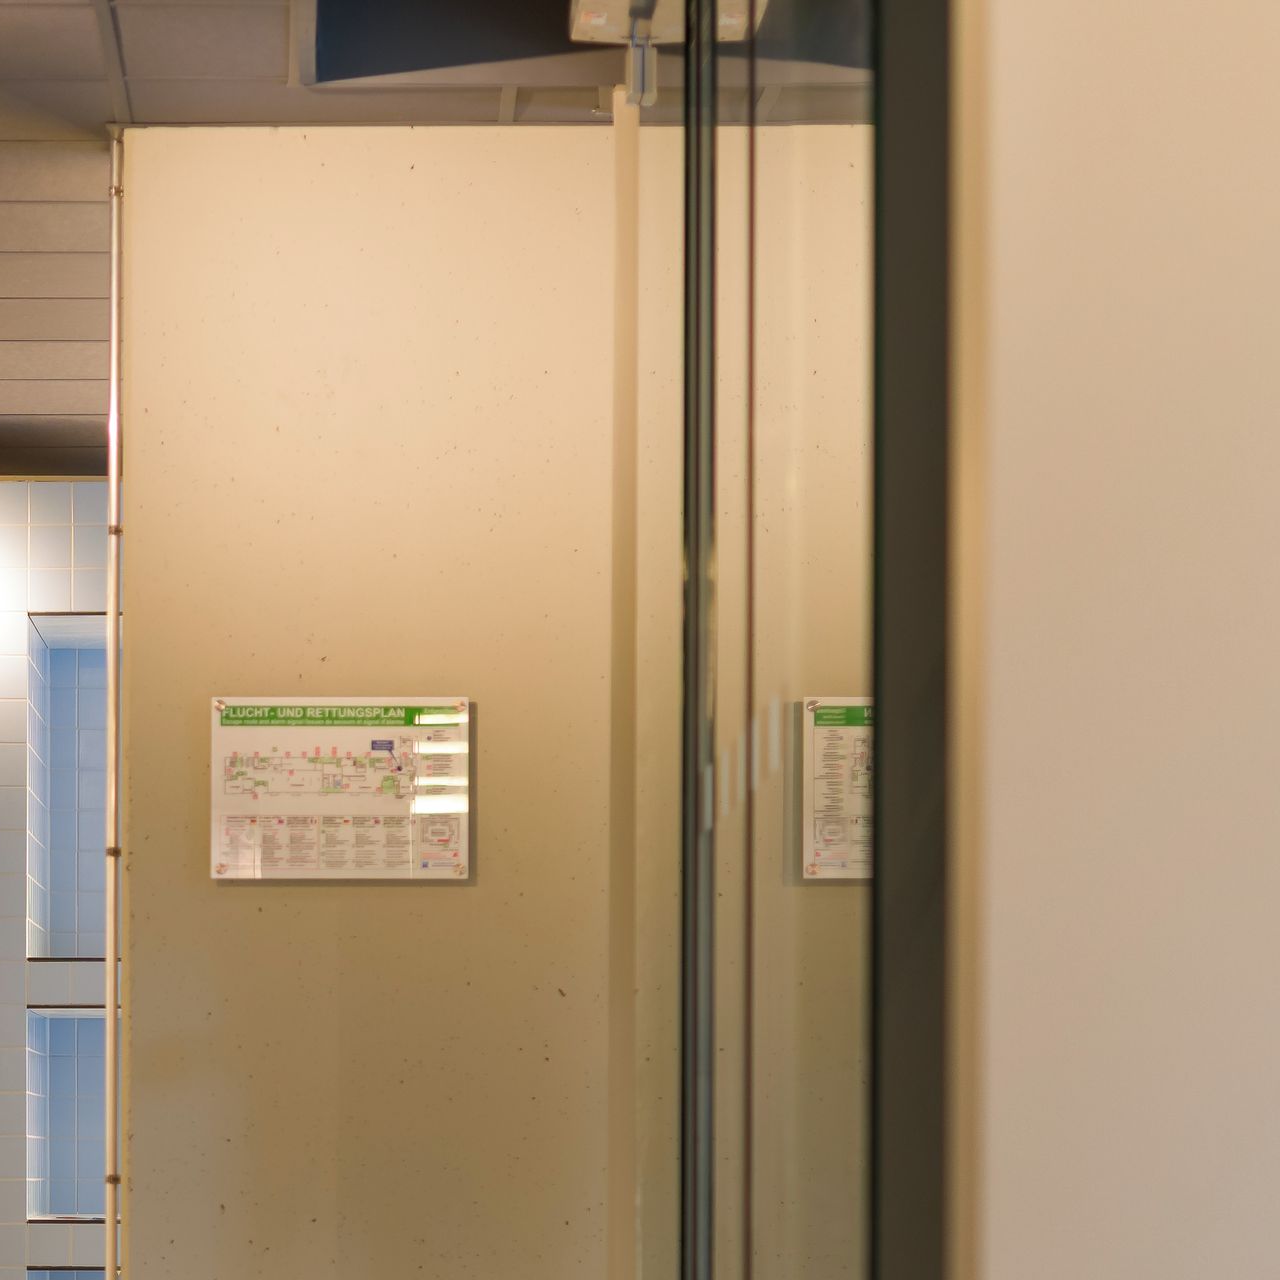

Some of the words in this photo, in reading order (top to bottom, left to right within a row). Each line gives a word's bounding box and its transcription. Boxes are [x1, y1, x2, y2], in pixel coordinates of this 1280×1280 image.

[222, 707, 275, 718] FLUCHT-
[277, 707, 305, 718] UND
[306, 707, 406, 718] RETTUNGSPLAN
